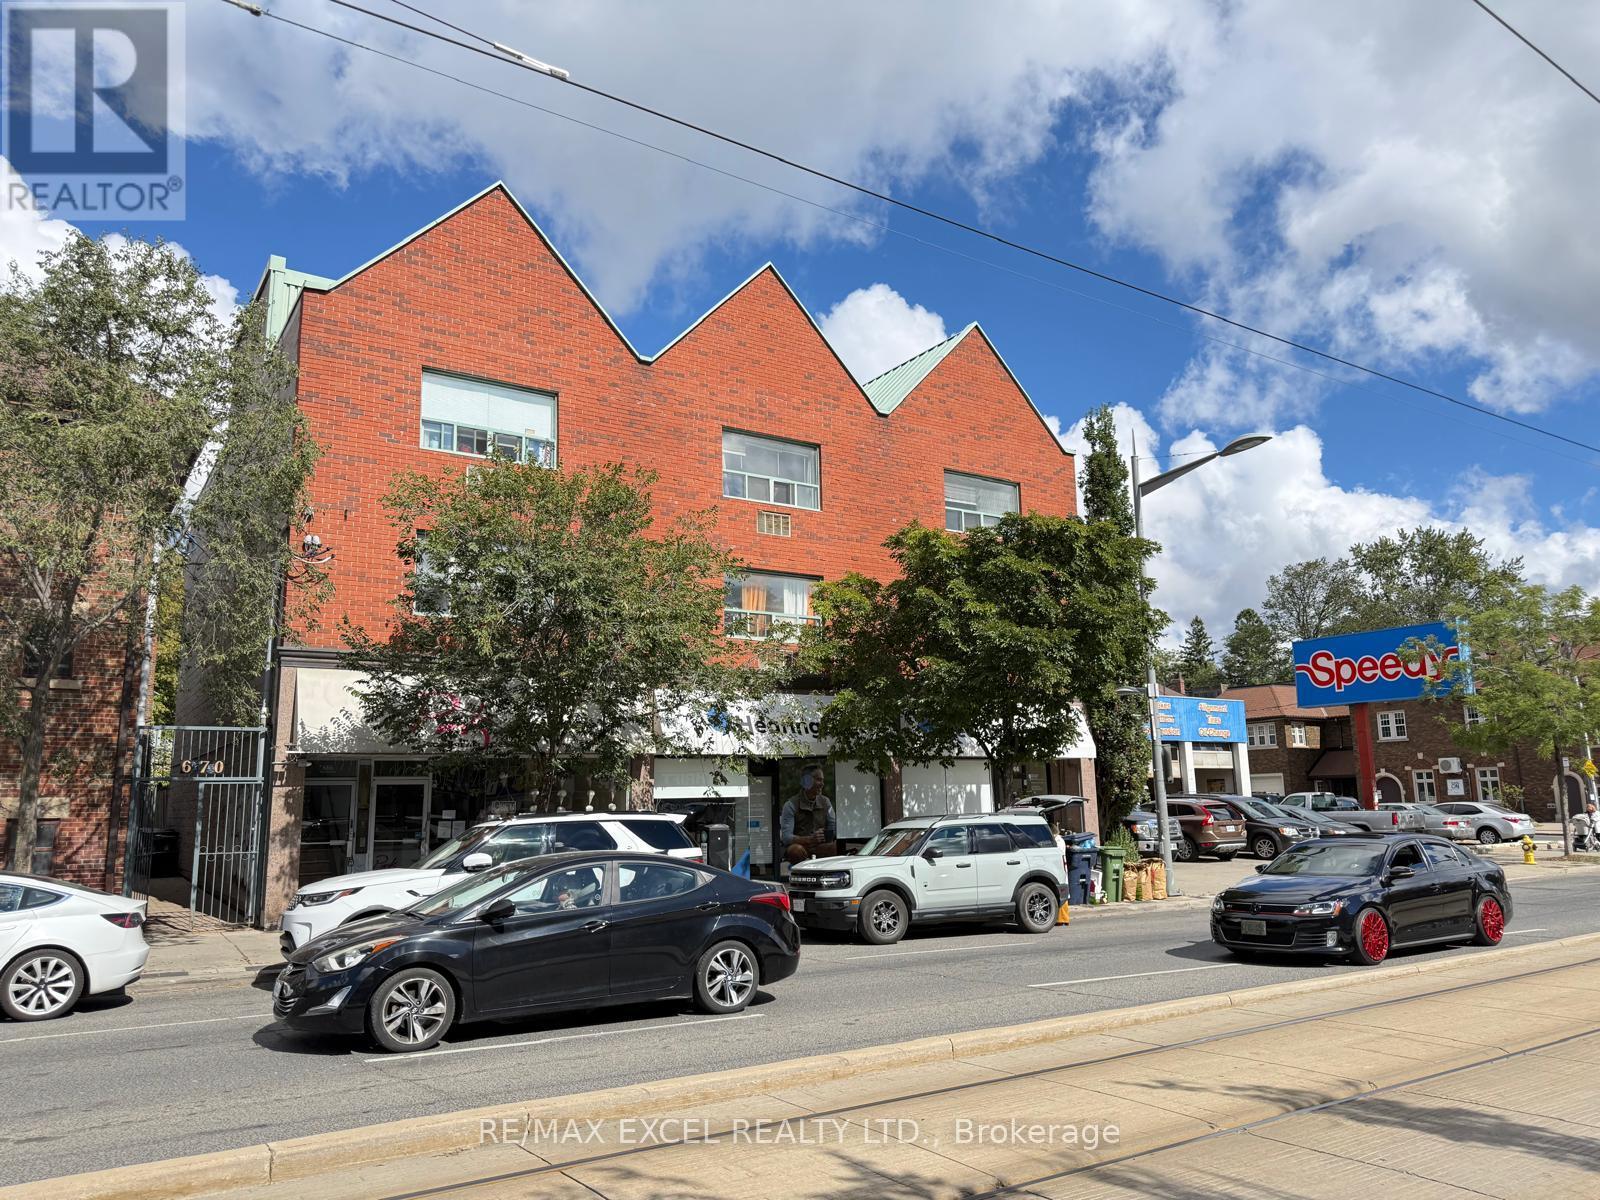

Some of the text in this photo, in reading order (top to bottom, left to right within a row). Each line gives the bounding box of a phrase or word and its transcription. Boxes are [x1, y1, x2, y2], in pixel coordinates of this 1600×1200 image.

[1296, 645, 1458, 692] Speedy
[1198, 702, 1228, 713] Alignment
[181, 760, 224, 774] 670
